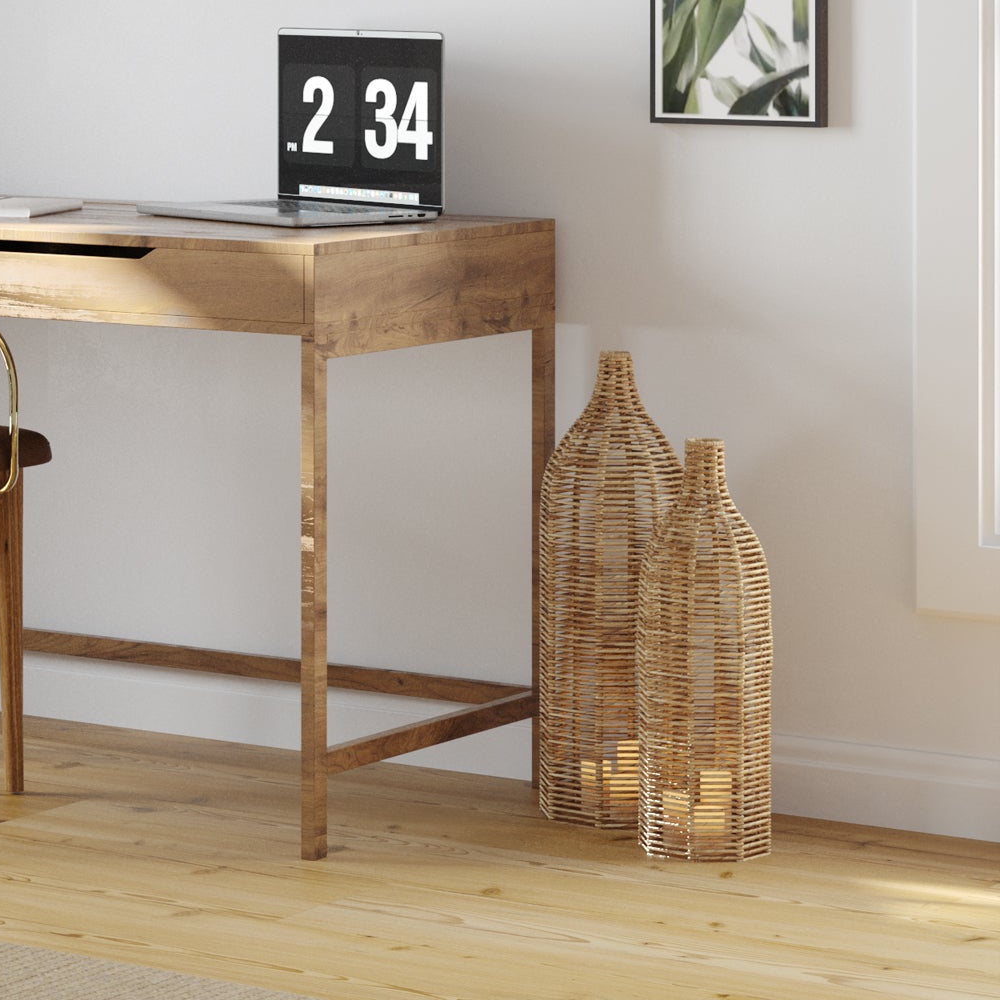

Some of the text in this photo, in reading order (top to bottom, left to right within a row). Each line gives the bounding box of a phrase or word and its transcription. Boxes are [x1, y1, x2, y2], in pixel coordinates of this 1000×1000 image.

[287, 75, 433, 161] PM 2 34
